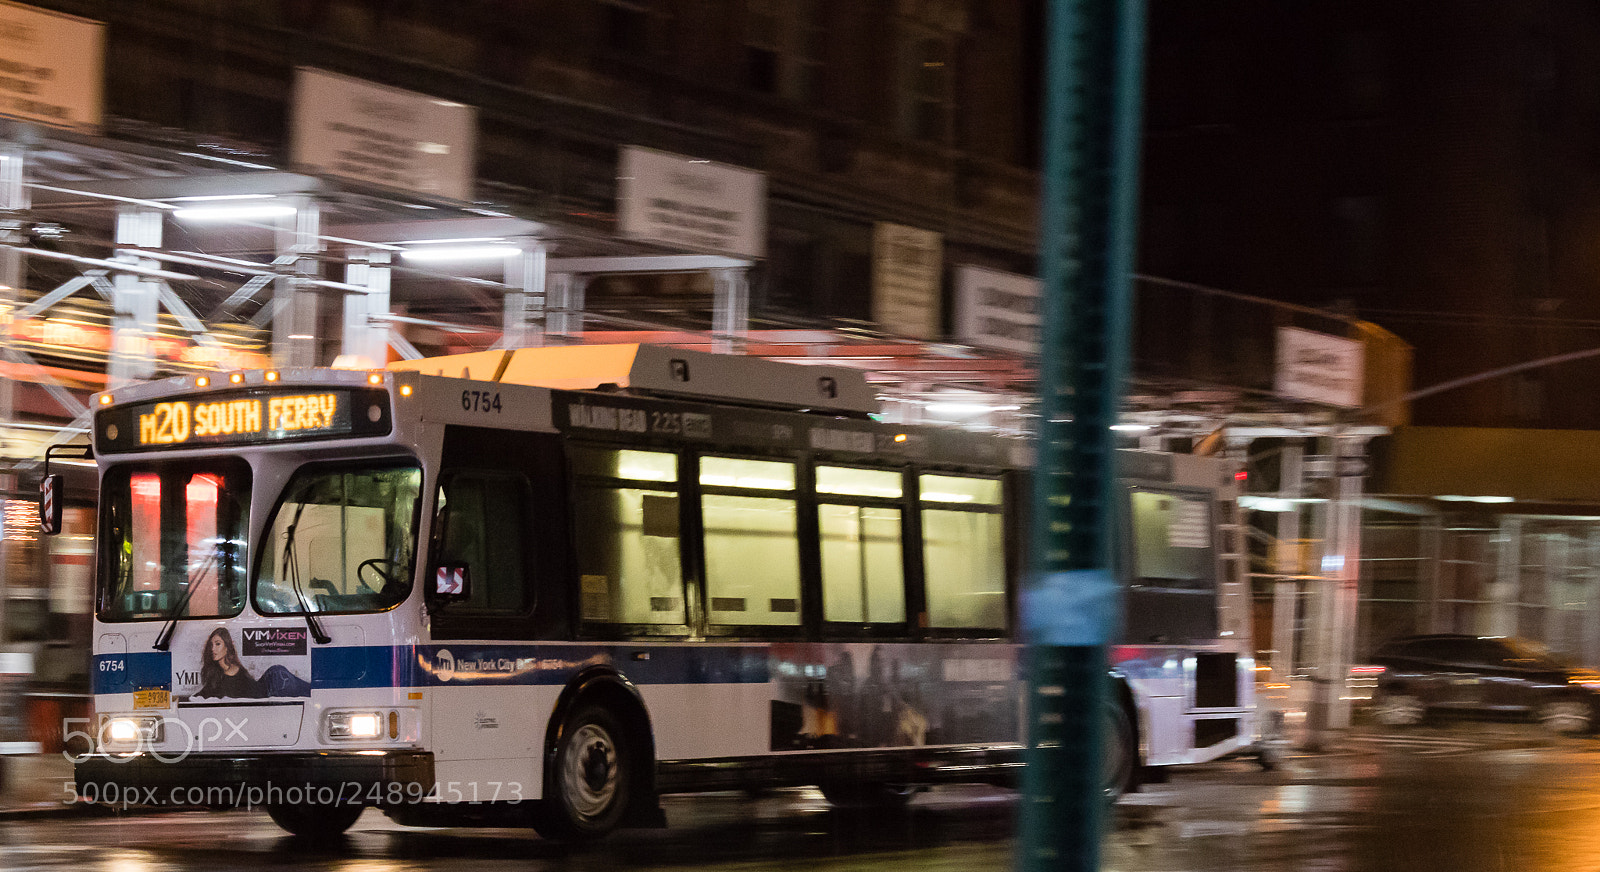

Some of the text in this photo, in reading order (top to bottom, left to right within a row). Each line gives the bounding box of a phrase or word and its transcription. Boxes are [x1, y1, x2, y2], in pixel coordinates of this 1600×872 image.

[461, 390, 503, 414] 6754
[140, 394, 336, 444] M20 SOUTH FERRY
[99, 660, 124, 672] 6754
[457, 659, 476, 671] New
[477, 659, 497, 671] York
[497, 658, 515, 673] City
[175, 669, 199, 686] YMI
